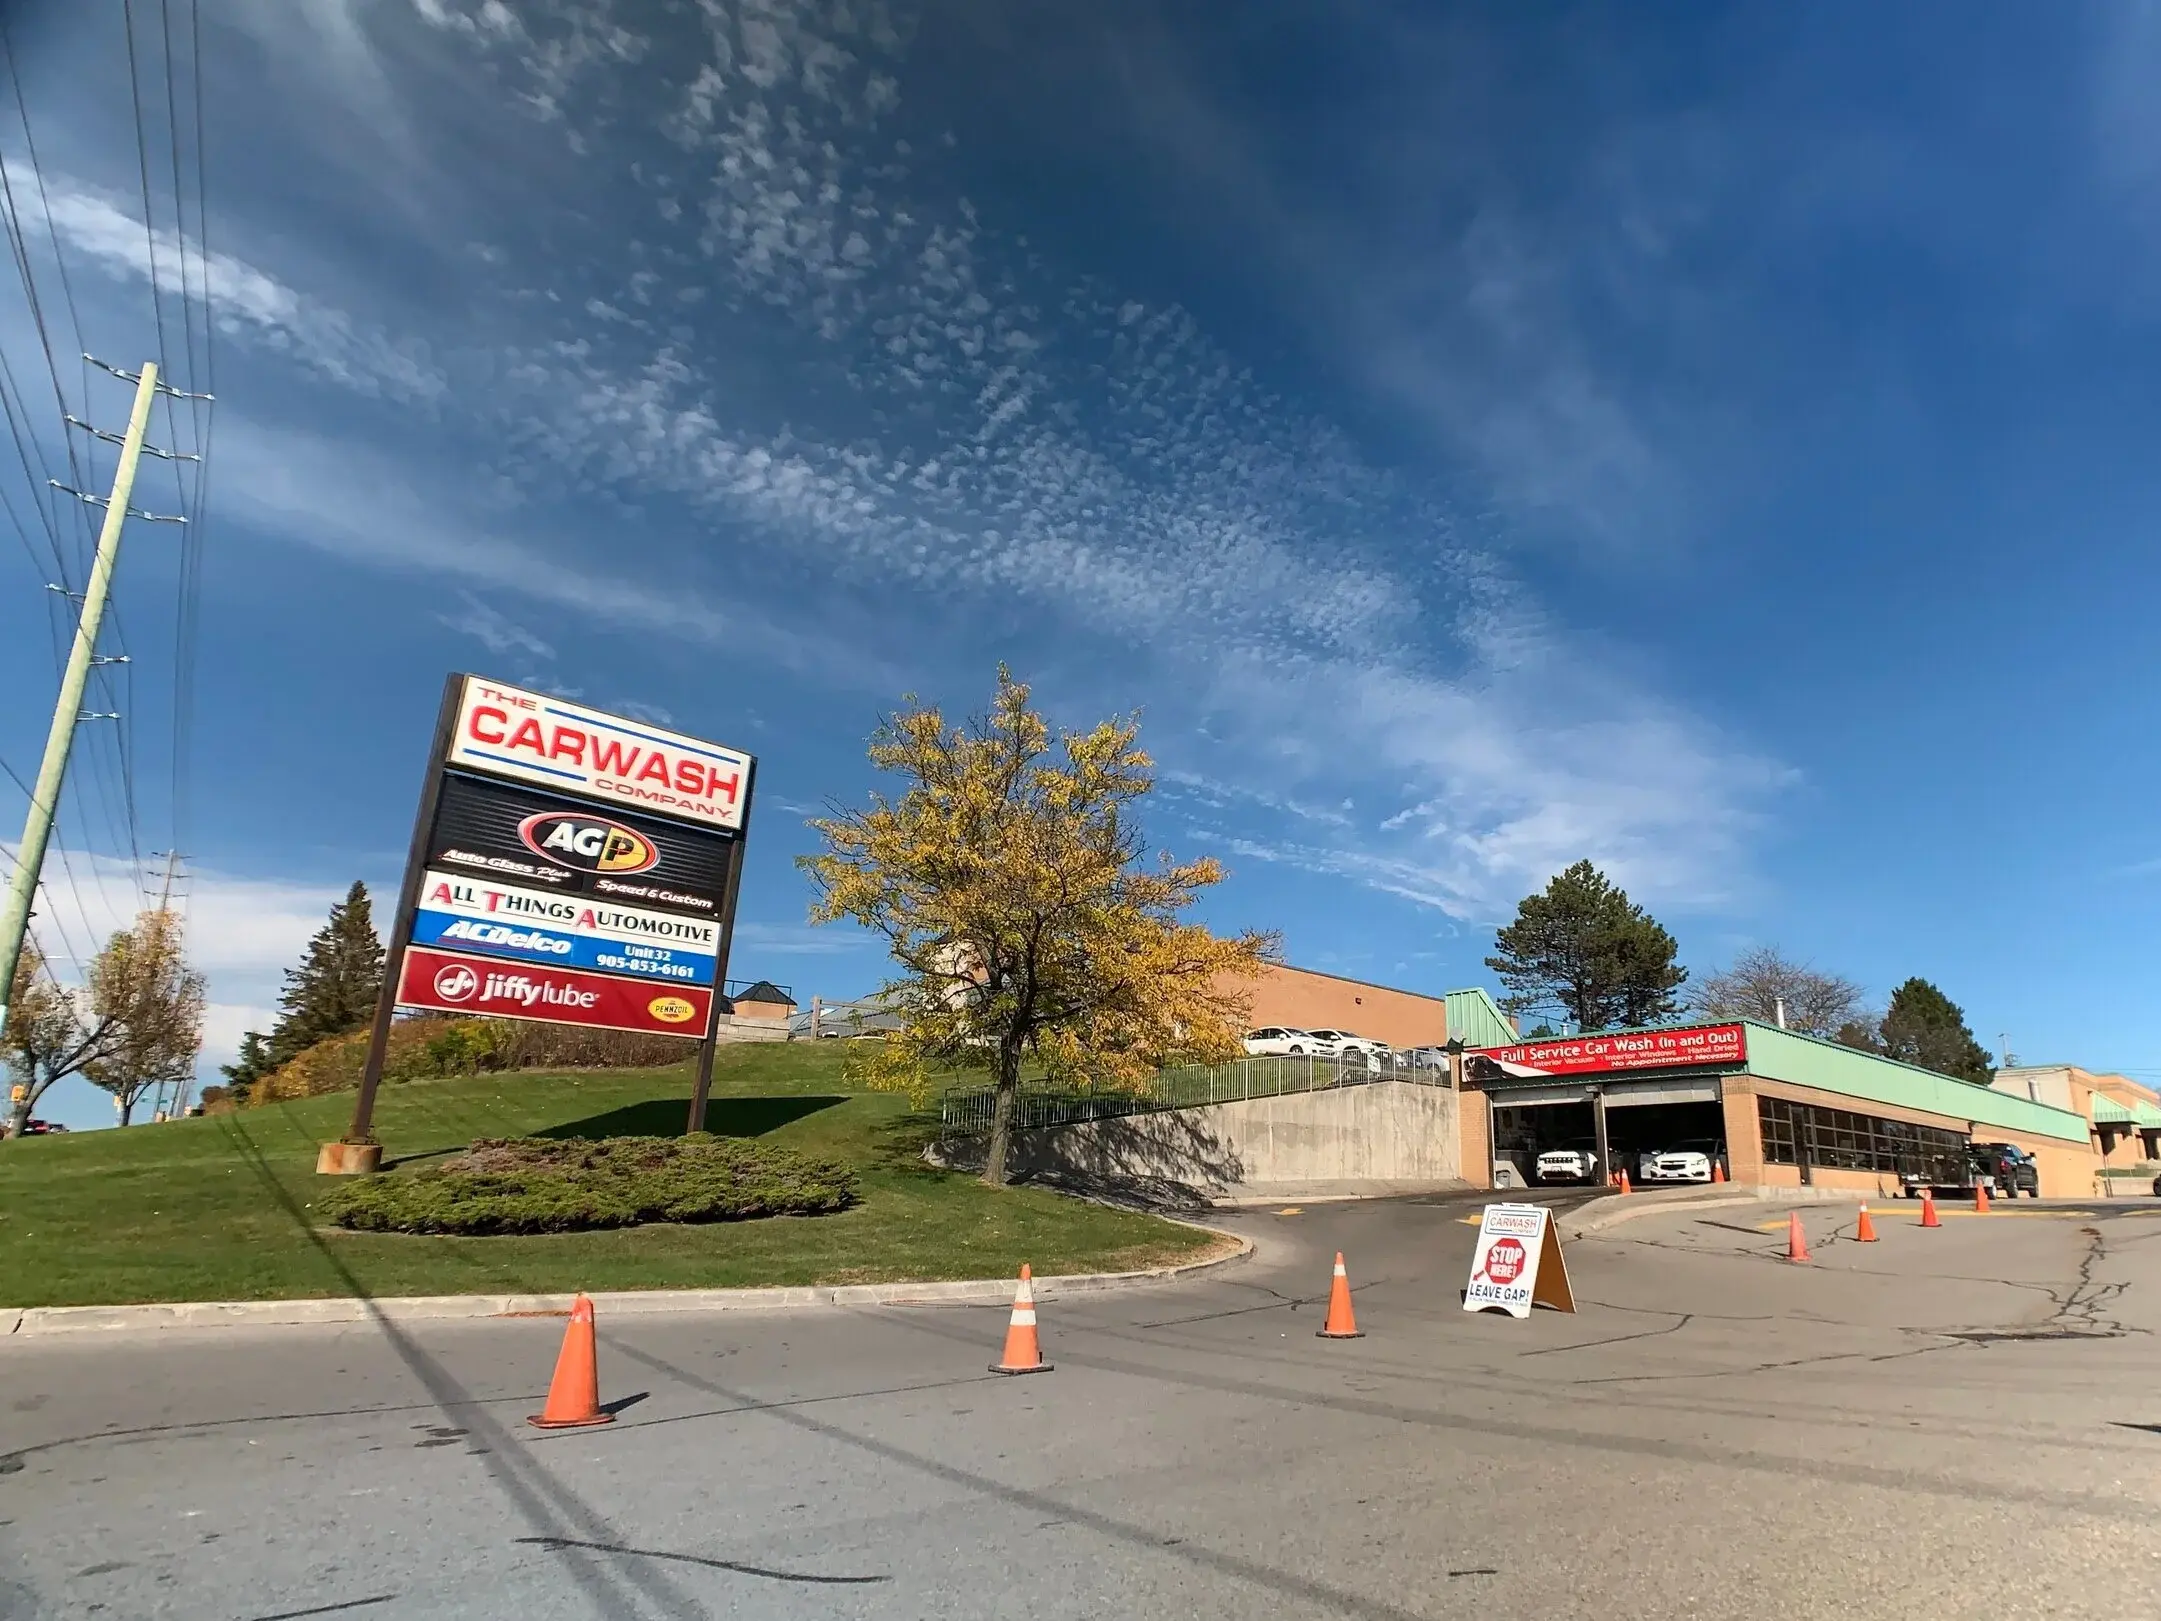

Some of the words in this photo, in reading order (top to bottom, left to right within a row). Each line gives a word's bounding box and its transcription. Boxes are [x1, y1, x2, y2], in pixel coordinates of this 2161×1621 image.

[477, 686, 537, 711] THE
[469, 705, 740, 804] CARWASH
[541, 822, 635, 861] AGP
[442, 849, 487, 864] Auto
[488, 858, 534, 873] Glass
[536, 866, 572, 878] Plus
[596, 880, 648, 896] Speed
[659, 891, 714, 909] Custom
[430, 883, 476, 904] ALL
[482, 890, 575, 920] THINGS
[576, 908, 713, 942] AUTOMOTIVE
[441, 920, 572, 954] ACDelco
[625, 945, 654, 960] Unit
[655, 949, 672, 961] 32
[596, 954, 695, 978] 905-853-6161
[655, 1005, 688, 1014] PENNZOIL
[1501, 1048, 1526, 1063] Full
[1529, 1044, 1580, 1060] Service
[1585, 1042, 1610, 1055] Car
[1614, 1037, 1654, 1052] Wash
[1658, 1036, 1676, 1049] (In
[1680, 1034, 1704, 1047] and
[1708, 1029, 1738, 1045] Out)
[1533, 1059, 1561, 1068] Interior
[1563, 1055, 1596, 1065] Vacuum
[1604, 1052, 1636, 1061] Interior
[1639, 1049, 1677, 1059] Windows
[1687, 1046, 1711, 1055] Hand
[1714, 1043, 1740, 1052] Dried
[1627, 1055, 1692, 1067] Appointment
[1695, 1051, 1739, 1061] Necessary
[1490, 1216, 1538, 1229] CARWASH
[1489, 1245, 1523, 1265] STOP
[1489, 1263, 1518, 1279] HERE!
[1469, 1283, 1502, 1299] LEAVE
[1504, 1287, 1530, 1302] GAP!
